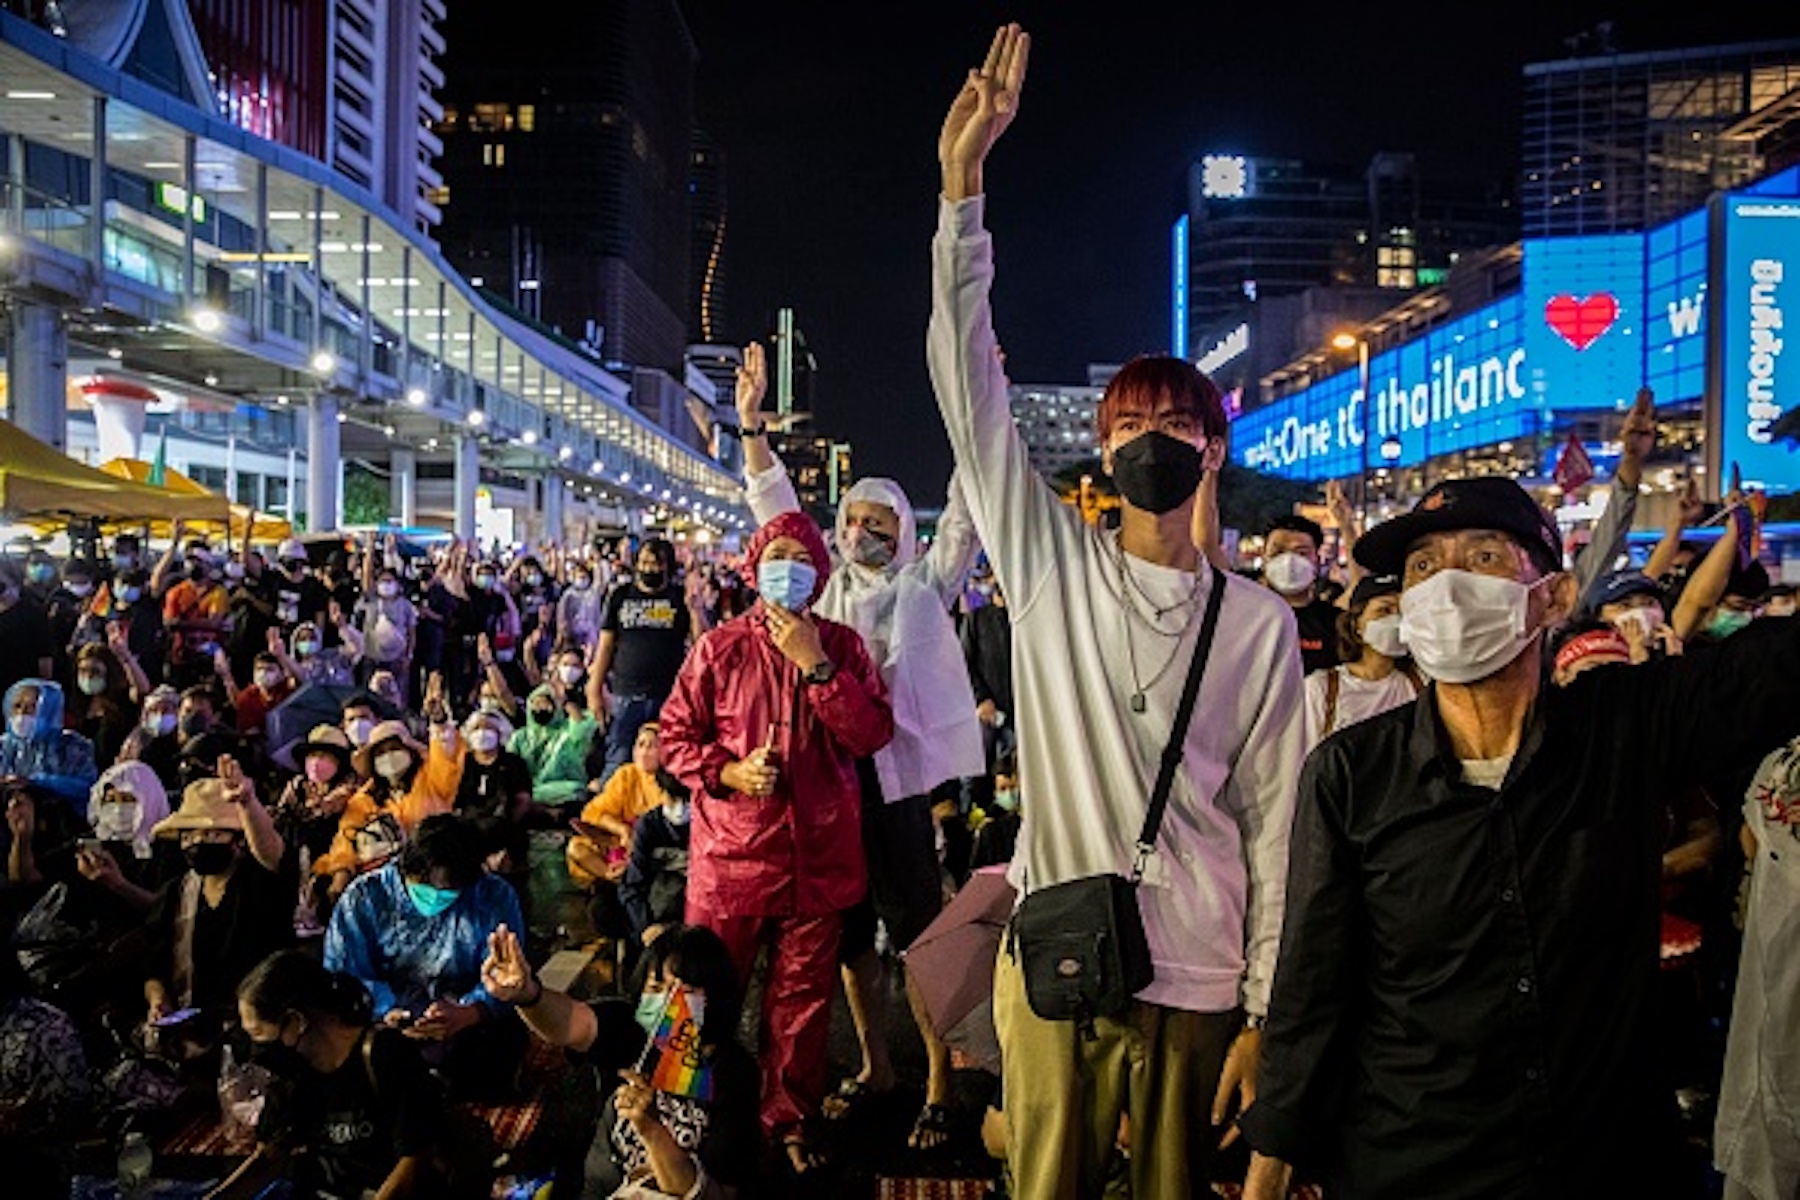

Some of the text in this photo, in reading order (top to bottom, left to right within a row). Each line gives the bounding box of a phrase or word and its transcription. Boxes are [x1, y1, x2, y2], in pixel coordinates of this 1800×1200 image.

[1747, 259, 1783, 444] ยินดีต้อนรับ
